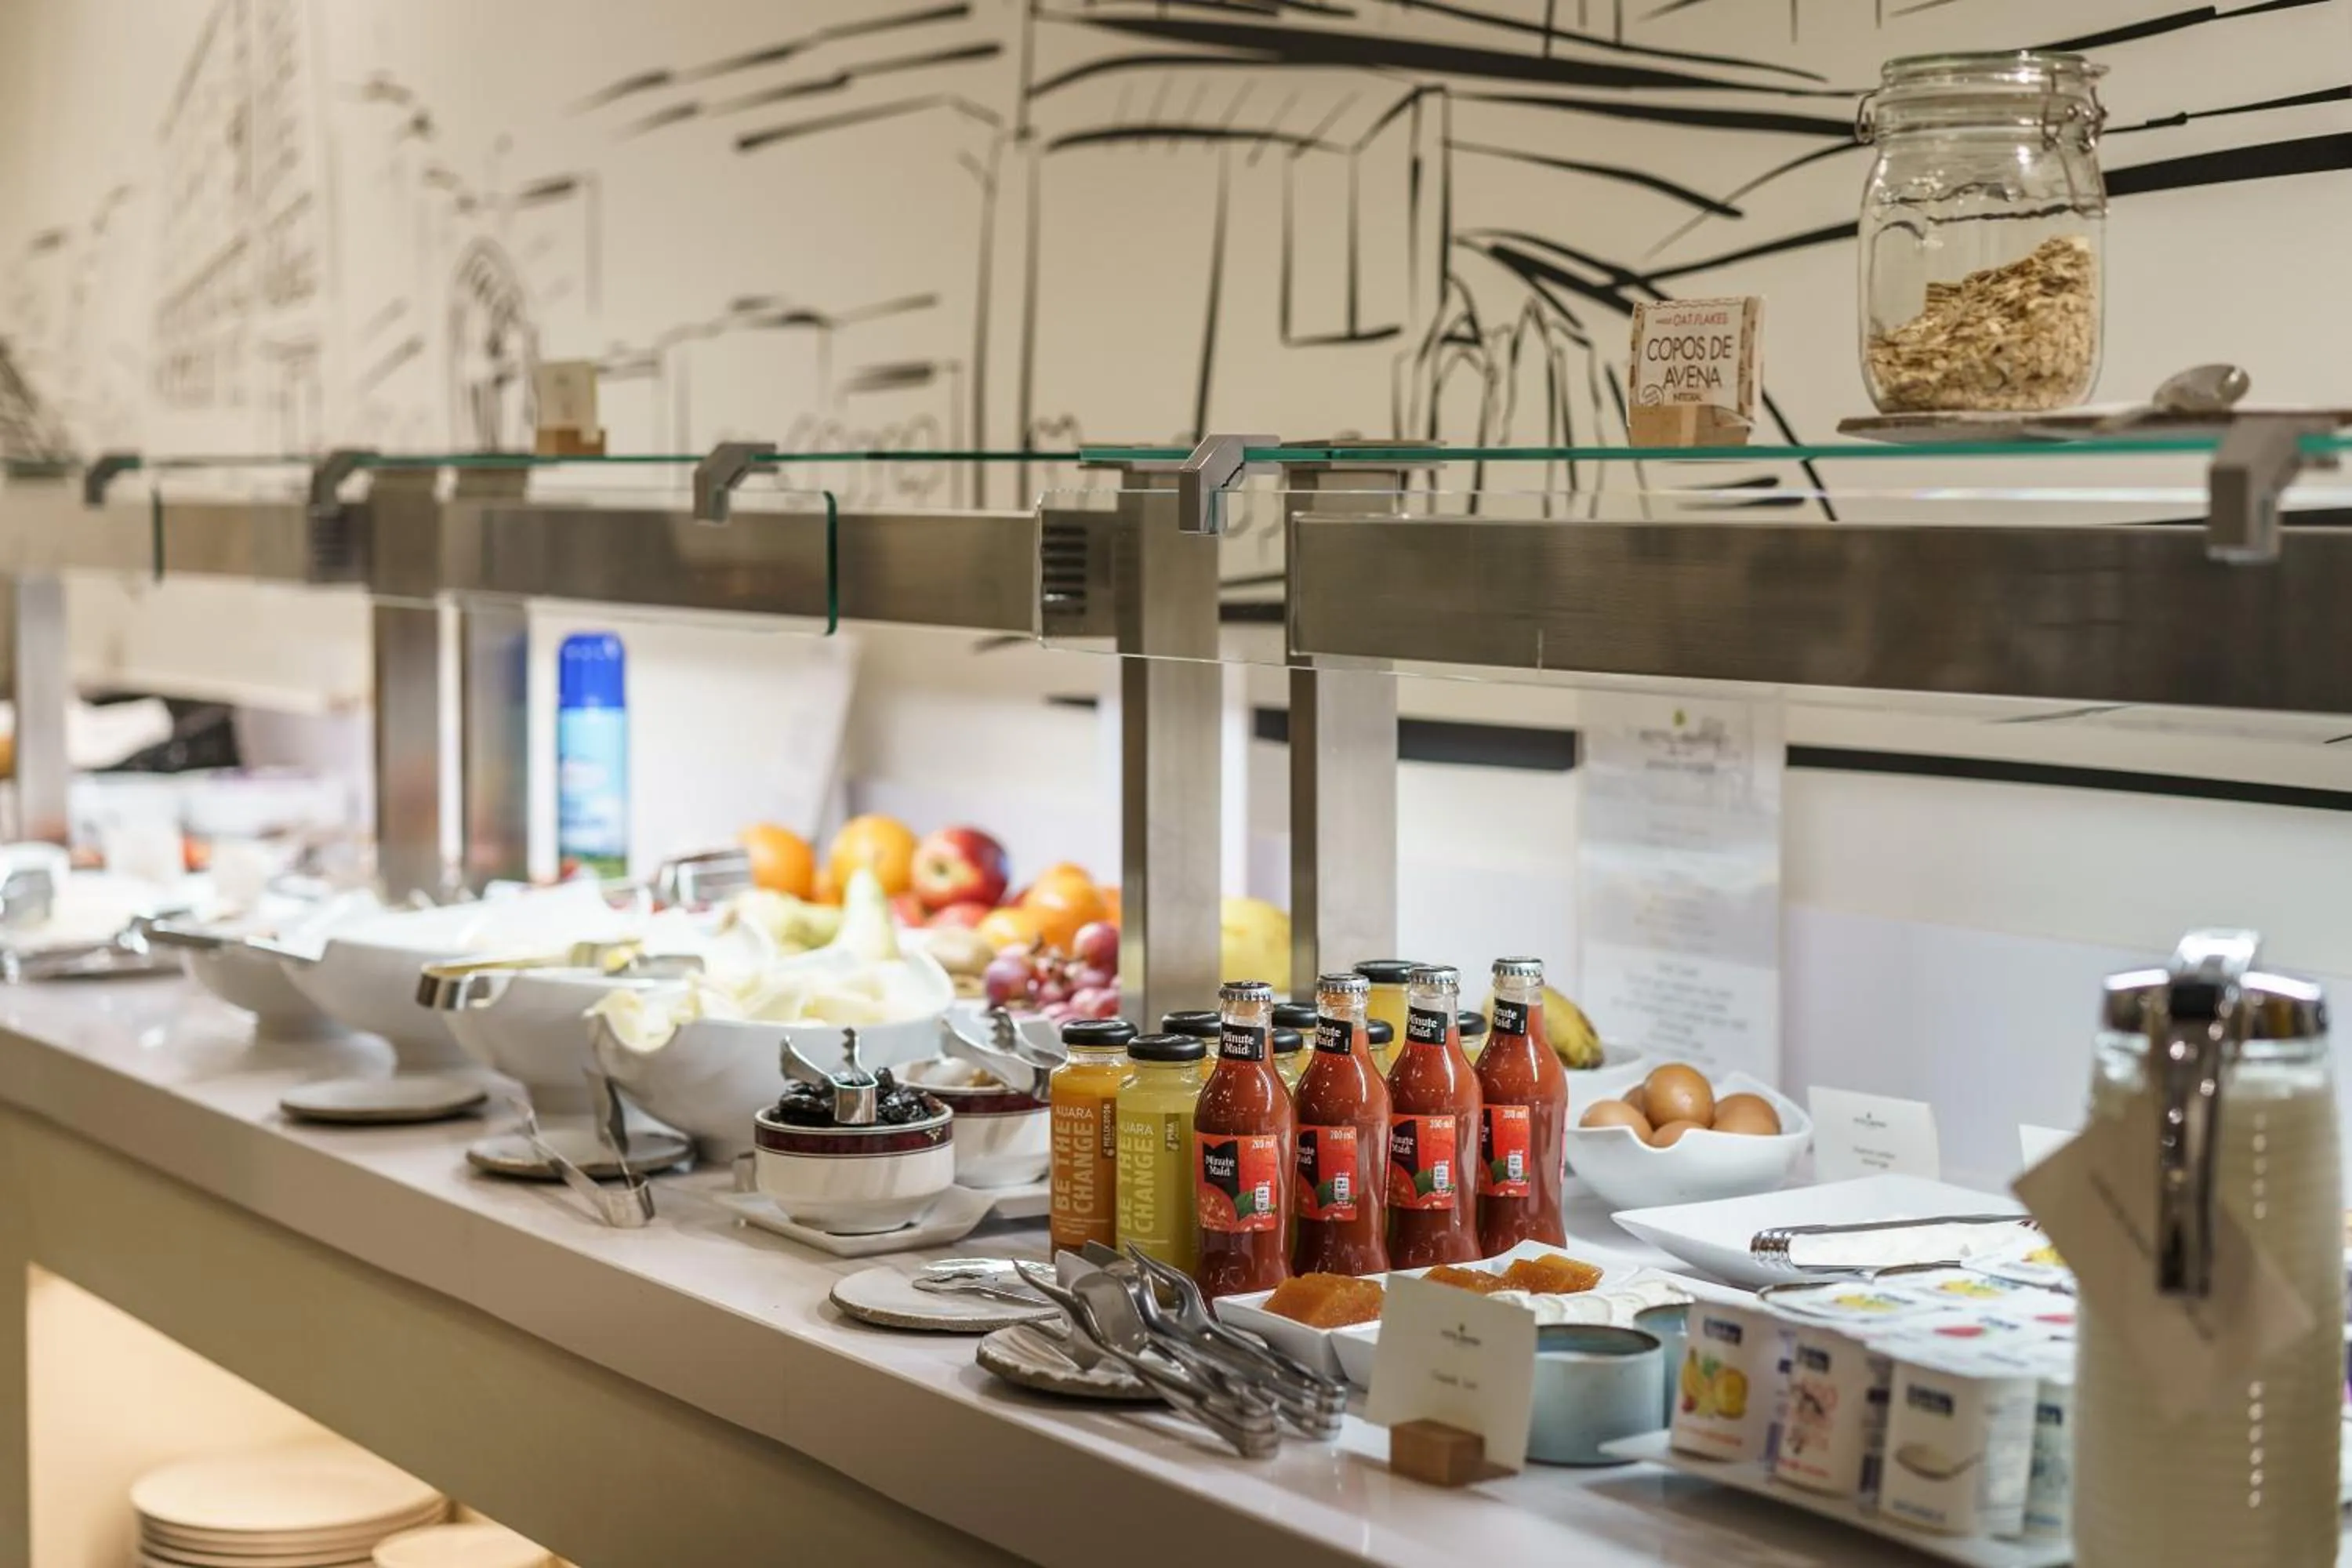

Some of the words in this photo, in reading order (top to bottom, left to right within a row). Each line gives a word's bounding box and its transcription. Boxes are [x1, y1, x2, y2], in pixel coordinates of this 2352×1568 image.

[1647, 336, 1705, 361] COPOS
[1710, 335, 1733, 360] DE
[1664, 365, 1722, 390] AVENA
[1224, 1043, 1250, 1055] Maid
[1055, 1119, 1071, 1167] THE
[1073, 1122, 1094, 1214] CHANGE
[1205, 1155, 1235, 1167] Minute
[1209, 1165, 1231, 1177] Maid
[1055, 1179, 1071, 1210] BE
[1134, 1137, 1154, 1233] CHANGE
